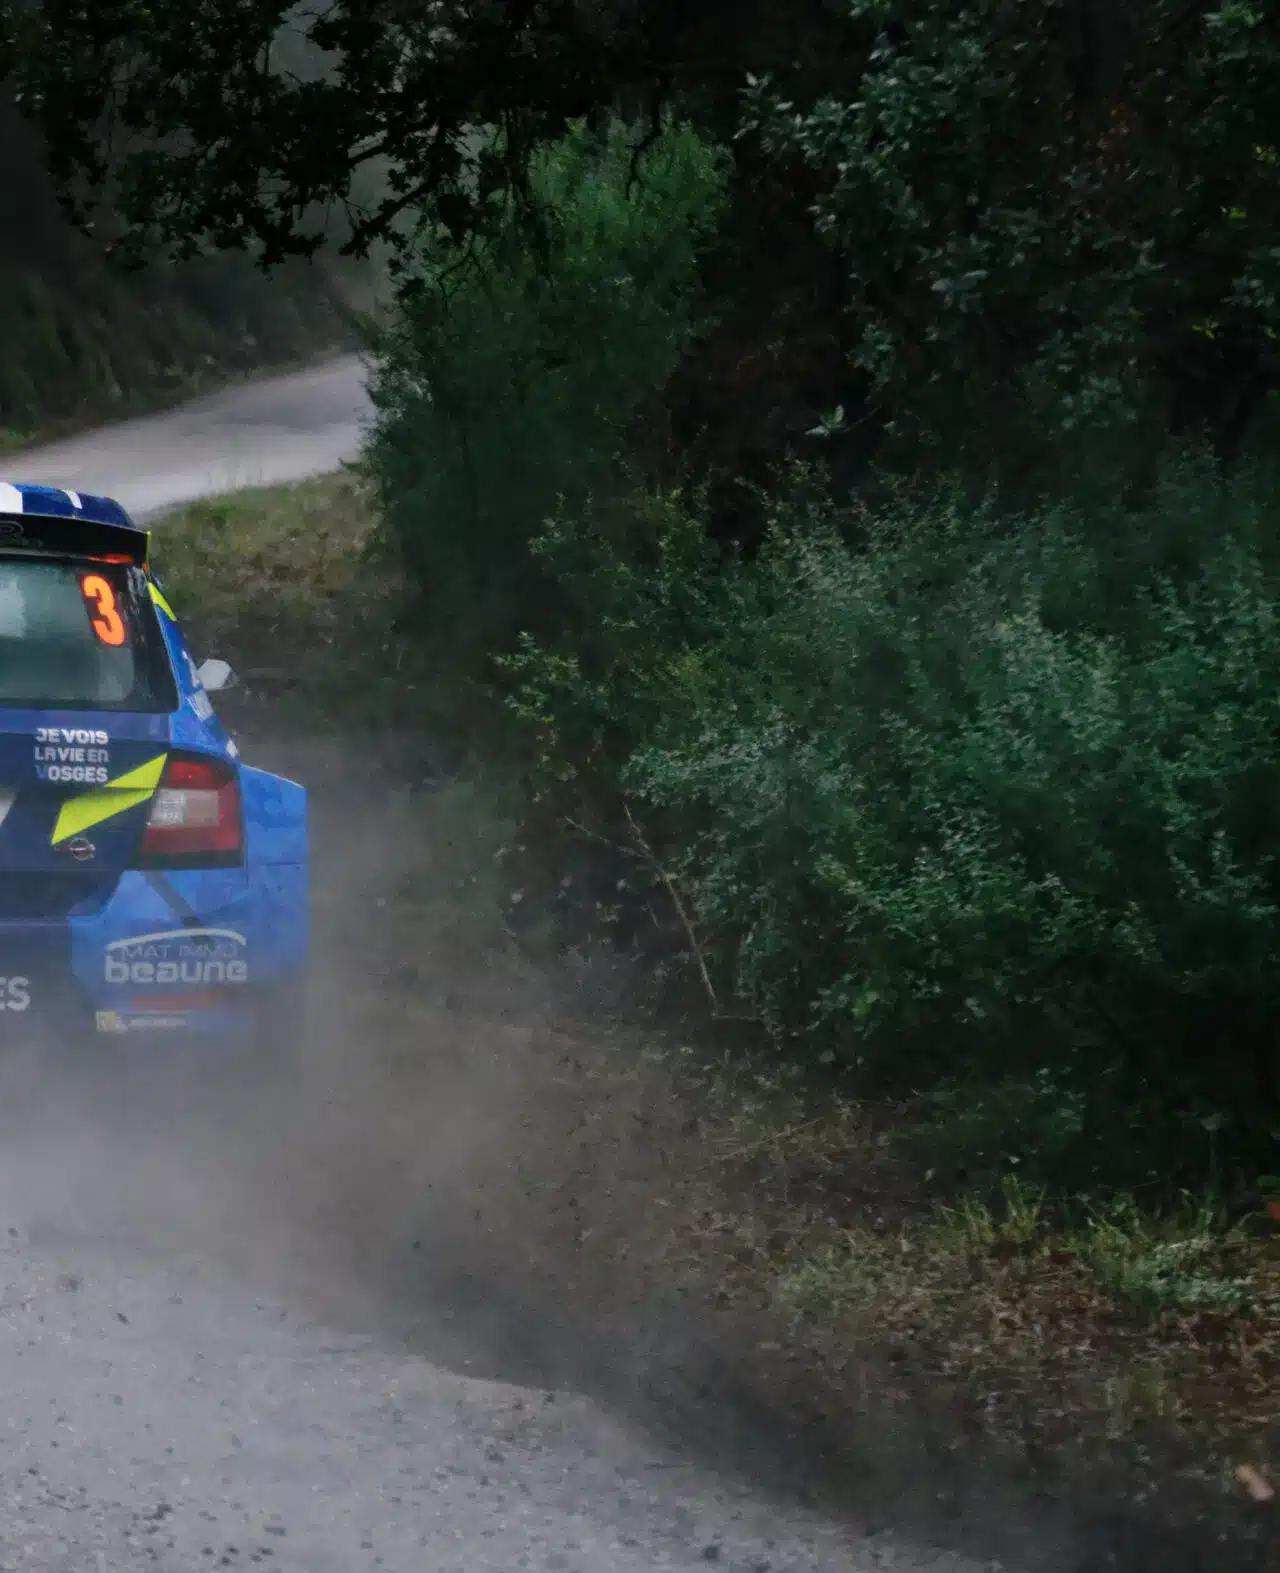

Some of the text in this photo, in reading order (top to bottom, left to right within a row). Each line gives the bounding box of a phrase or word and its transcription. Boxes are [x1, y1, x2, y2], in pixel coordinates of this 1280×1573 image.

[82, 574, 125, 646] 3
[35, 727, 109, 745] JE VOIS
[34, 746, 57, 761] LA
[58, 747, 85, 762] VIE
[35, 765, 108, 783] VOSGES
[104, 955, 248, 984] beaune
